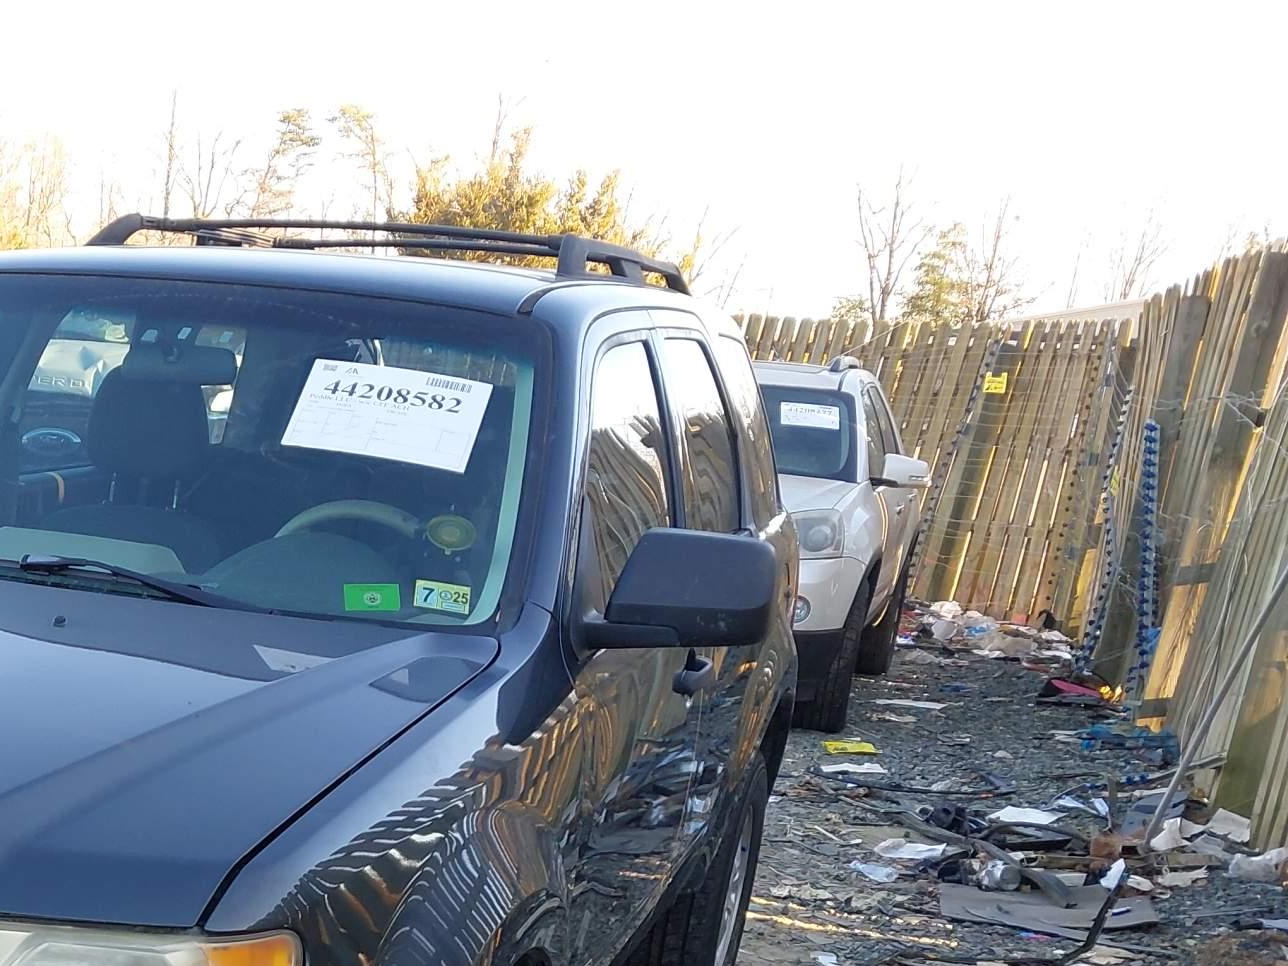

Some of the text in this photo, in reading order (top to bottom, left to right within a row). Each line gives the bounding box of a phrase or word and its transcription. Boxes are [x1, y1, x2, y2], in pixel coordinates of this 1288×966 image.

[324, 379, 462, 414] 44208582
[421, 586, 469, 605] 7 25
